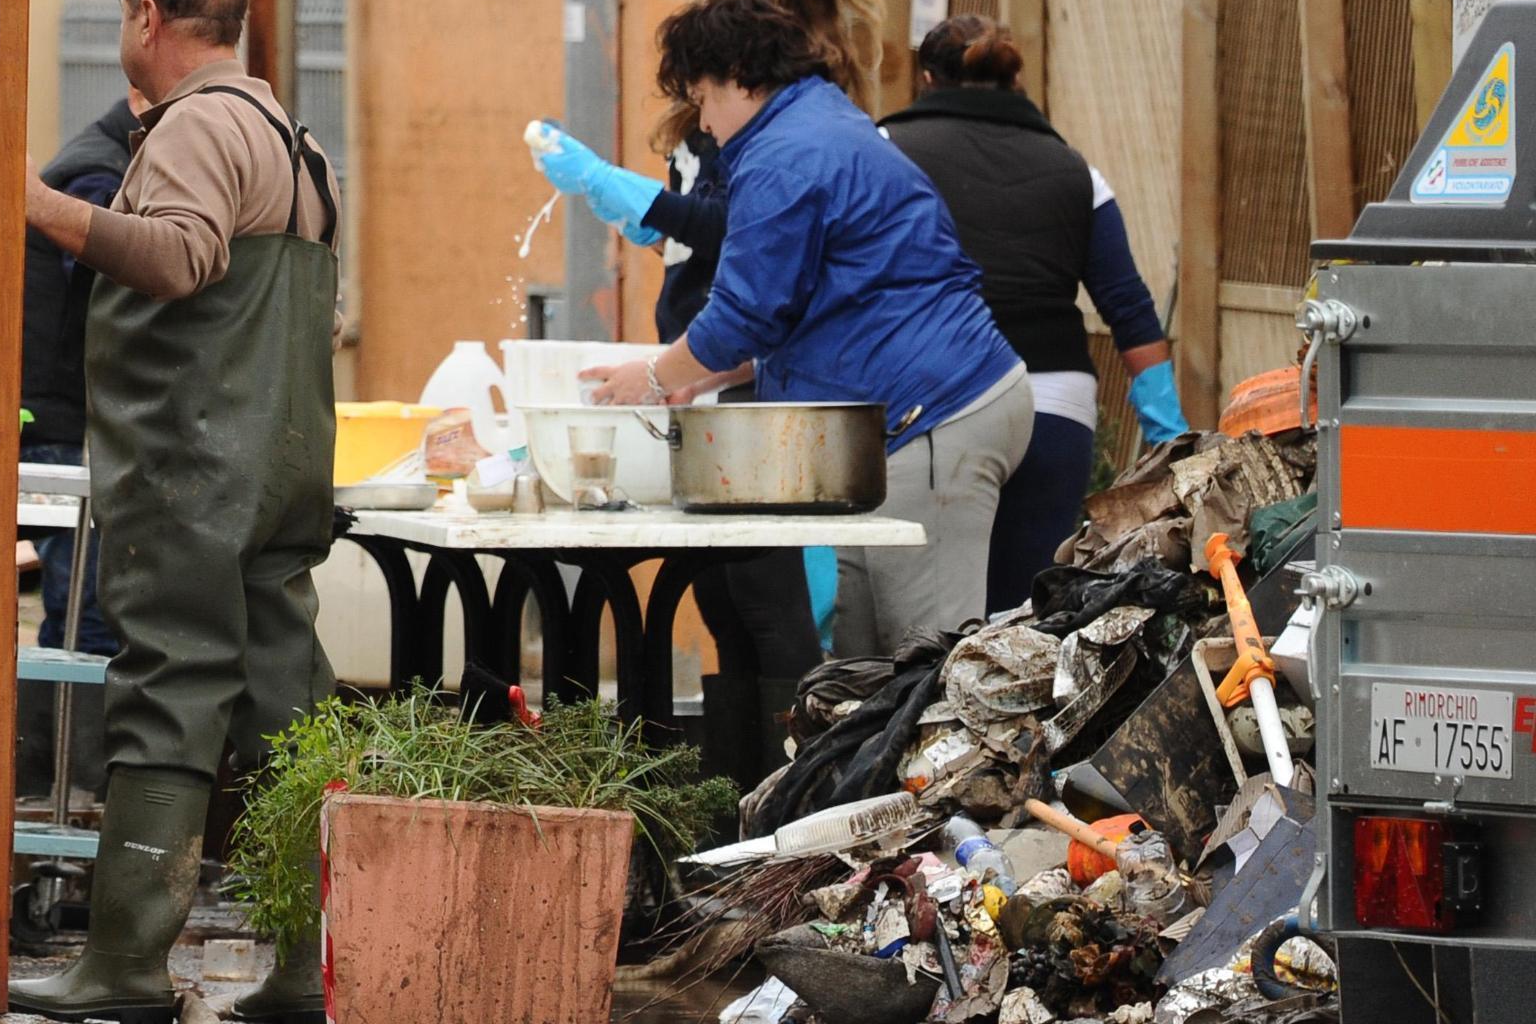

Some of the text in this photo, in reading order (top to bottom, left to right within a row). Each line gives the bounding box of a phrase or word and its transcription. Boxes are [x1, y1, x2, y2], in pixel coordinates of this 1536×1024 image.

[1405, 691, 1478, 721] RIMORCHIO
[1378, 718, 1504, 772] AF 17555
